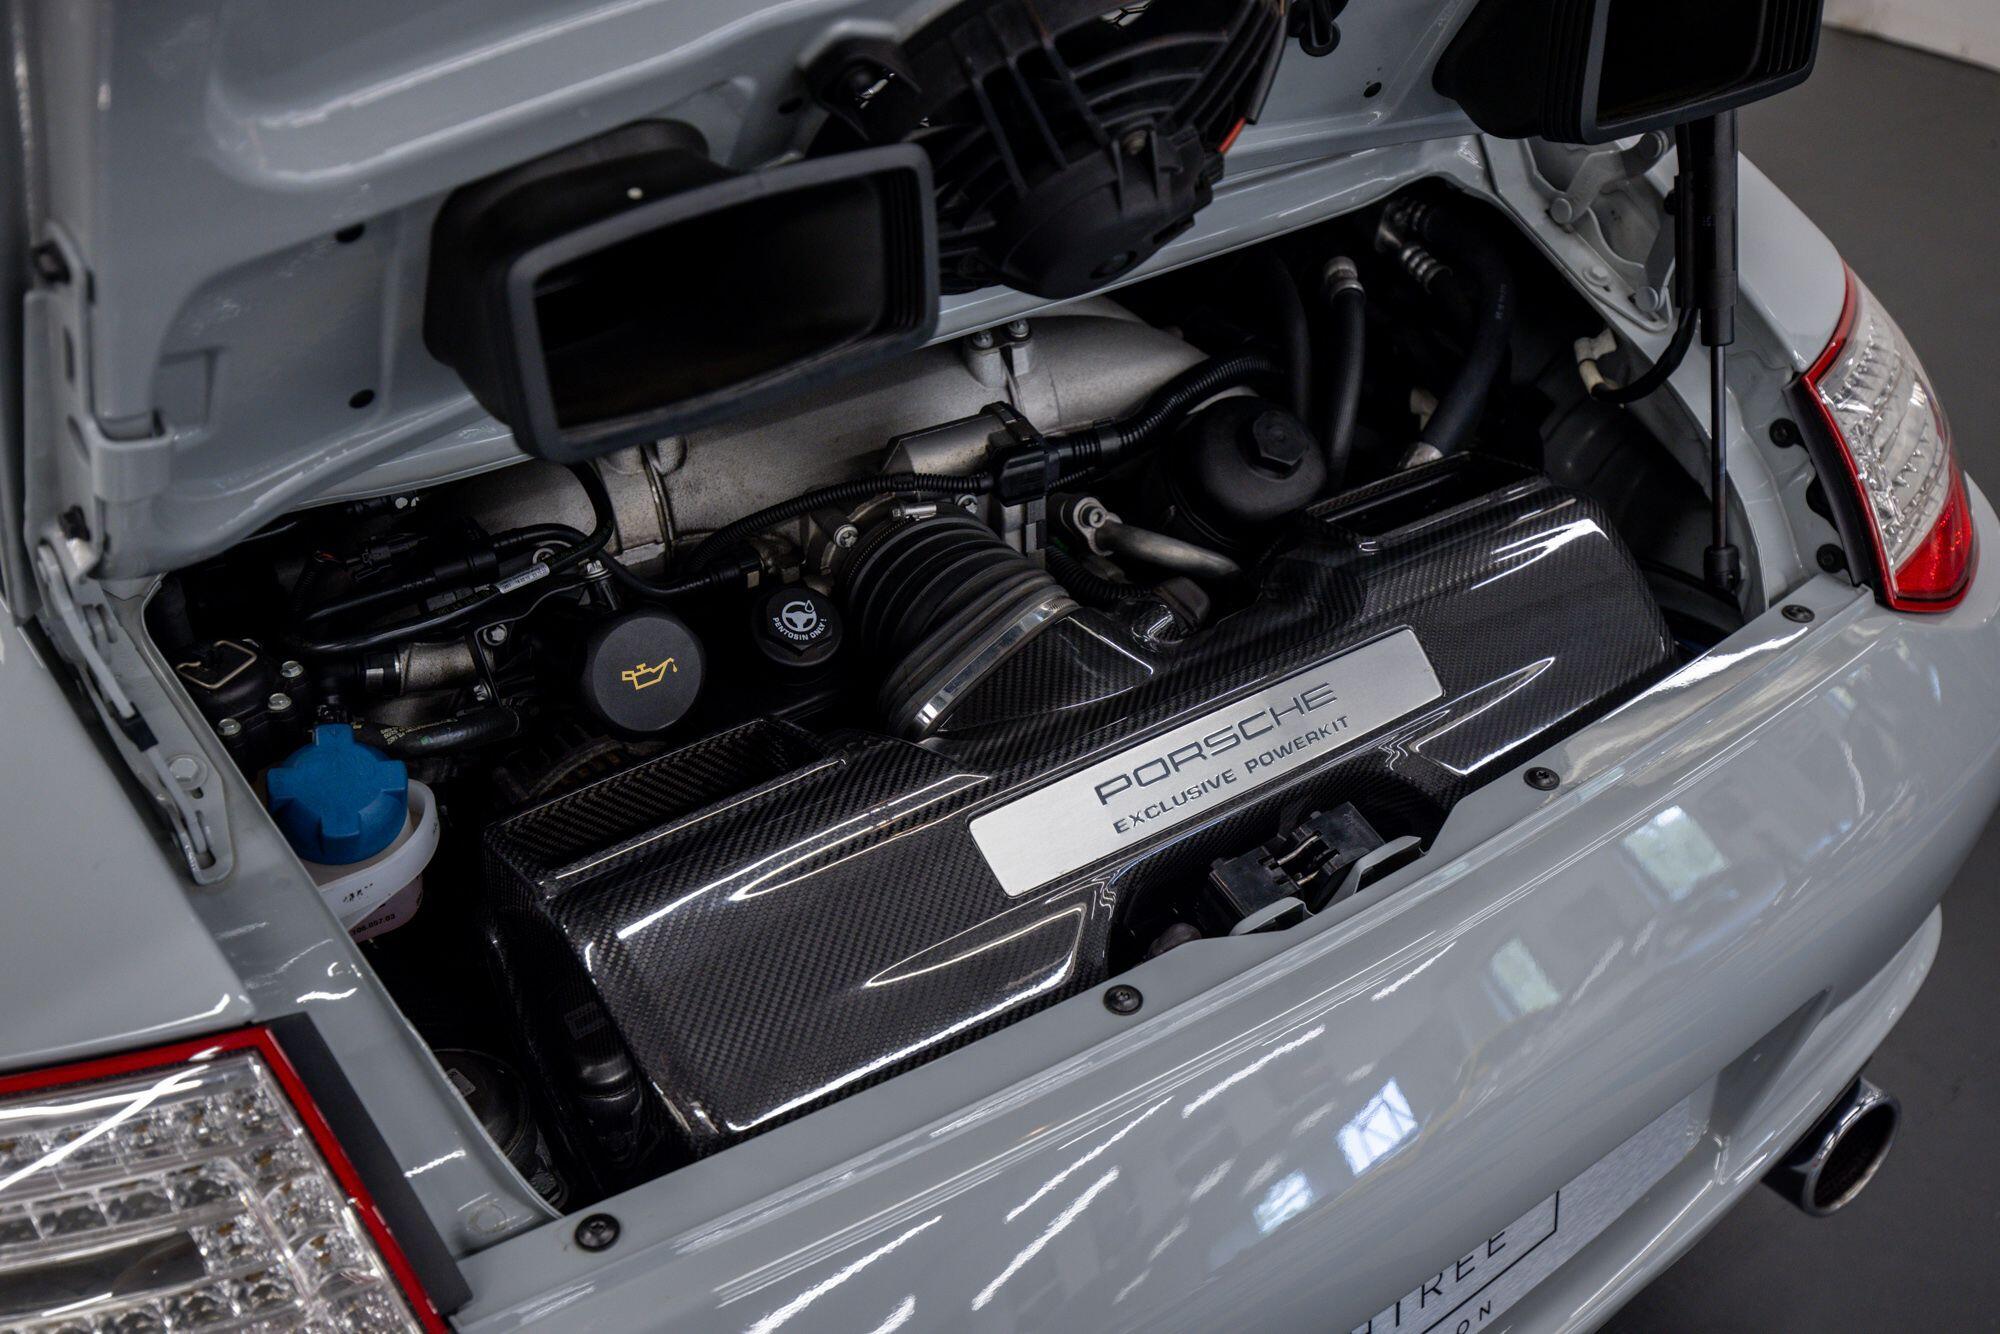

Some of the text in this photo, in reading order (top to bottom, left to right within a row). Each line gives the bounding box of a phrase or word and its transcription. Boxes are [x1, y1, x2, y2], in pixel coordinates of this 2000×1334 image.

[772, 617, 809, 641] PENTOSIN
[1094, 681, 1338, 806] PORSCHE
[1112, 716, 1350, 834] EXCLUSIVE POWERKIT
[1350, 1231, 1506, 1334] TREE
